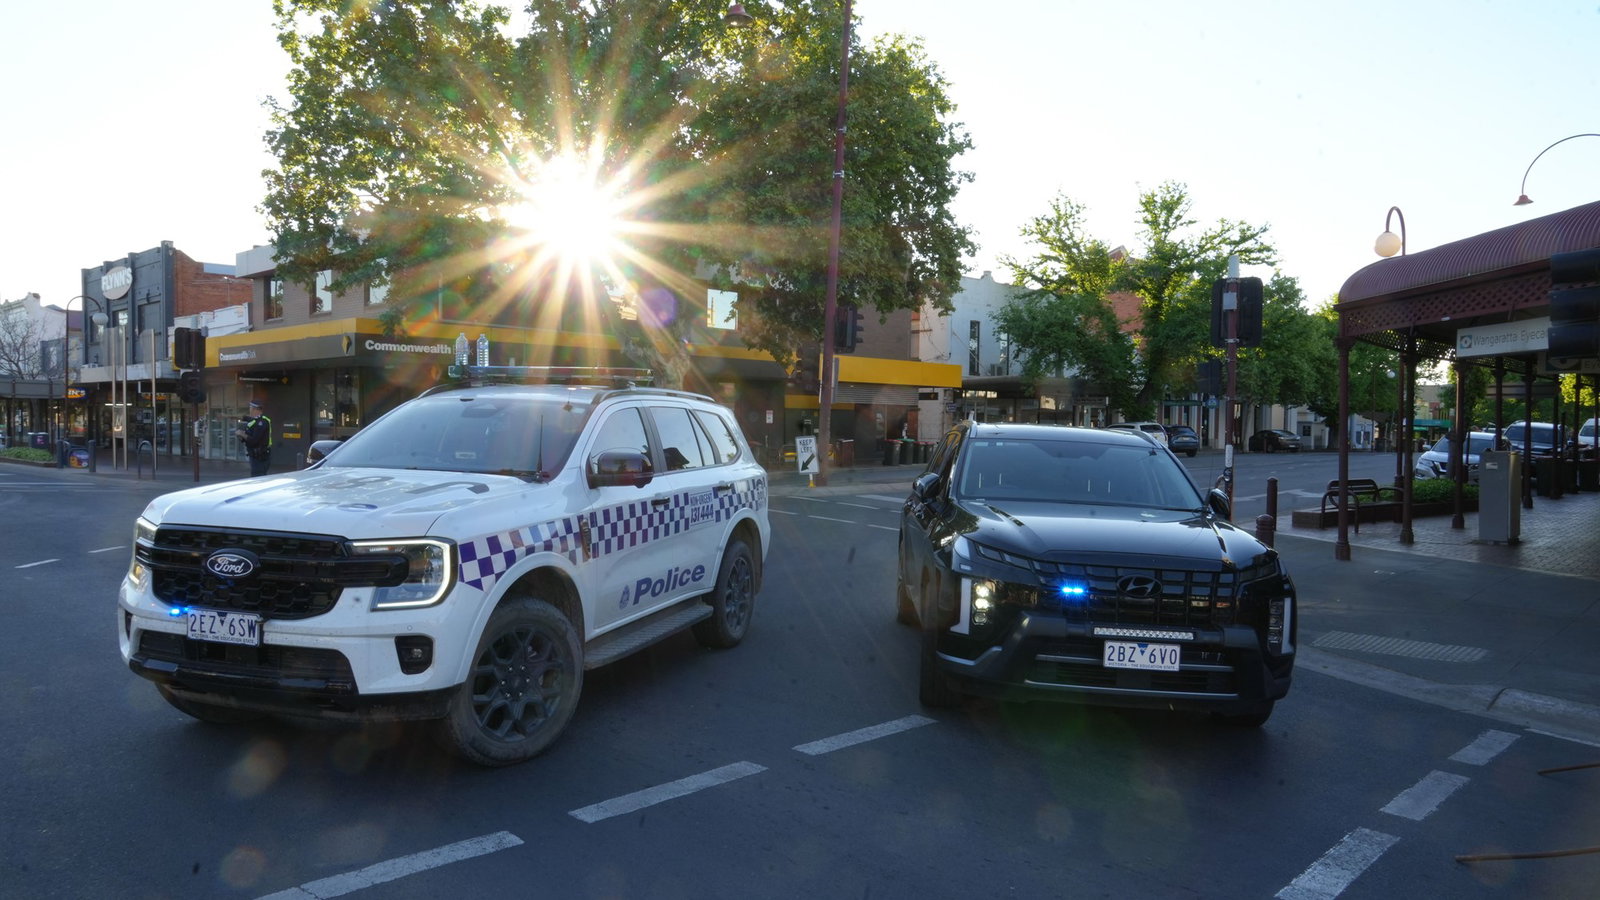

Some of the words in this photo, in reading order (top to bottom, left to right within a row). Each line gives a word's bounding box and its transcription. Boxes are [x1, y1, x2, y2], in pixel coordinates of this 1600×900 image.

[101, 266, 132, 291] FLYNN'S
[365, 340, 452, 354] Commonwealth
[1474, 332, 1517, 347] Wangaratta
[1520, 330, 1545, 344] Eyeca
[214, 556, 245, 573] Ford
[632, 564, 706, 606] Police
[190, 613, 216, 634] 2EZ
[229, 617, 257, 638] 6SW
[1107, 645, 1136, 663] 2BZ
